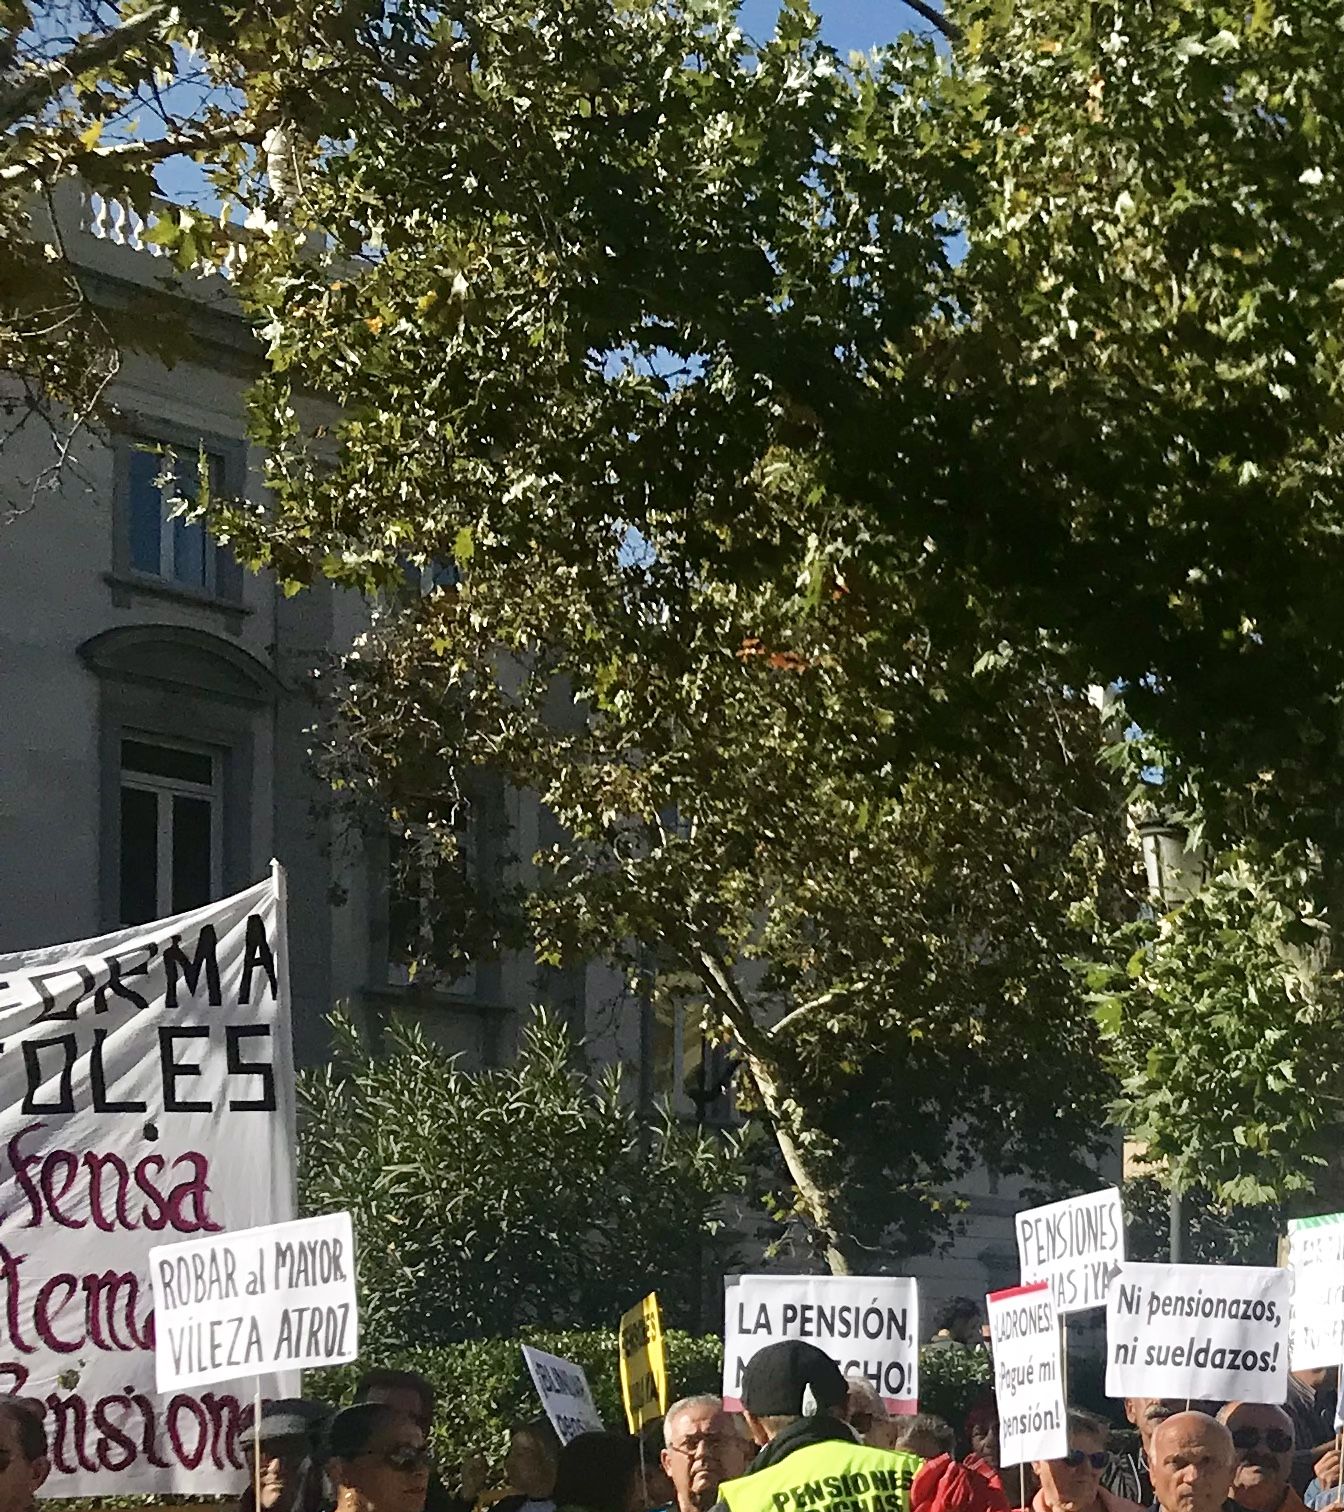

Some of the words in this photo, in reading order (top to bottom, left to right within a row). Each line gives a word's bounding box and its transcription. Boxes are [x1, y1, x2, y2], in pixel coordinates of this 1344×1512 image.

[0, 914, 277, 1024] ORMA
[0, 1024, 276, 1115] OLES
[8, 1122, 224, 1233] fensa
[0, 1243, 155, 1353] tem
[159, 1247, 238, 1310] ROBAR
[1117, 1284, 1142, 1315] Ni
[1147, 1288, 1281, 1328] pensionazos,
[738, 1302, 772, 1335] LA
[782, 1297, 913, 1348] PENSIÓN,
[1039, 1353, 1056, 1382] mi
[1114, 1336, 1138, 1365] ni
[1144, 1337, 1280, 1373] sueldazos!
